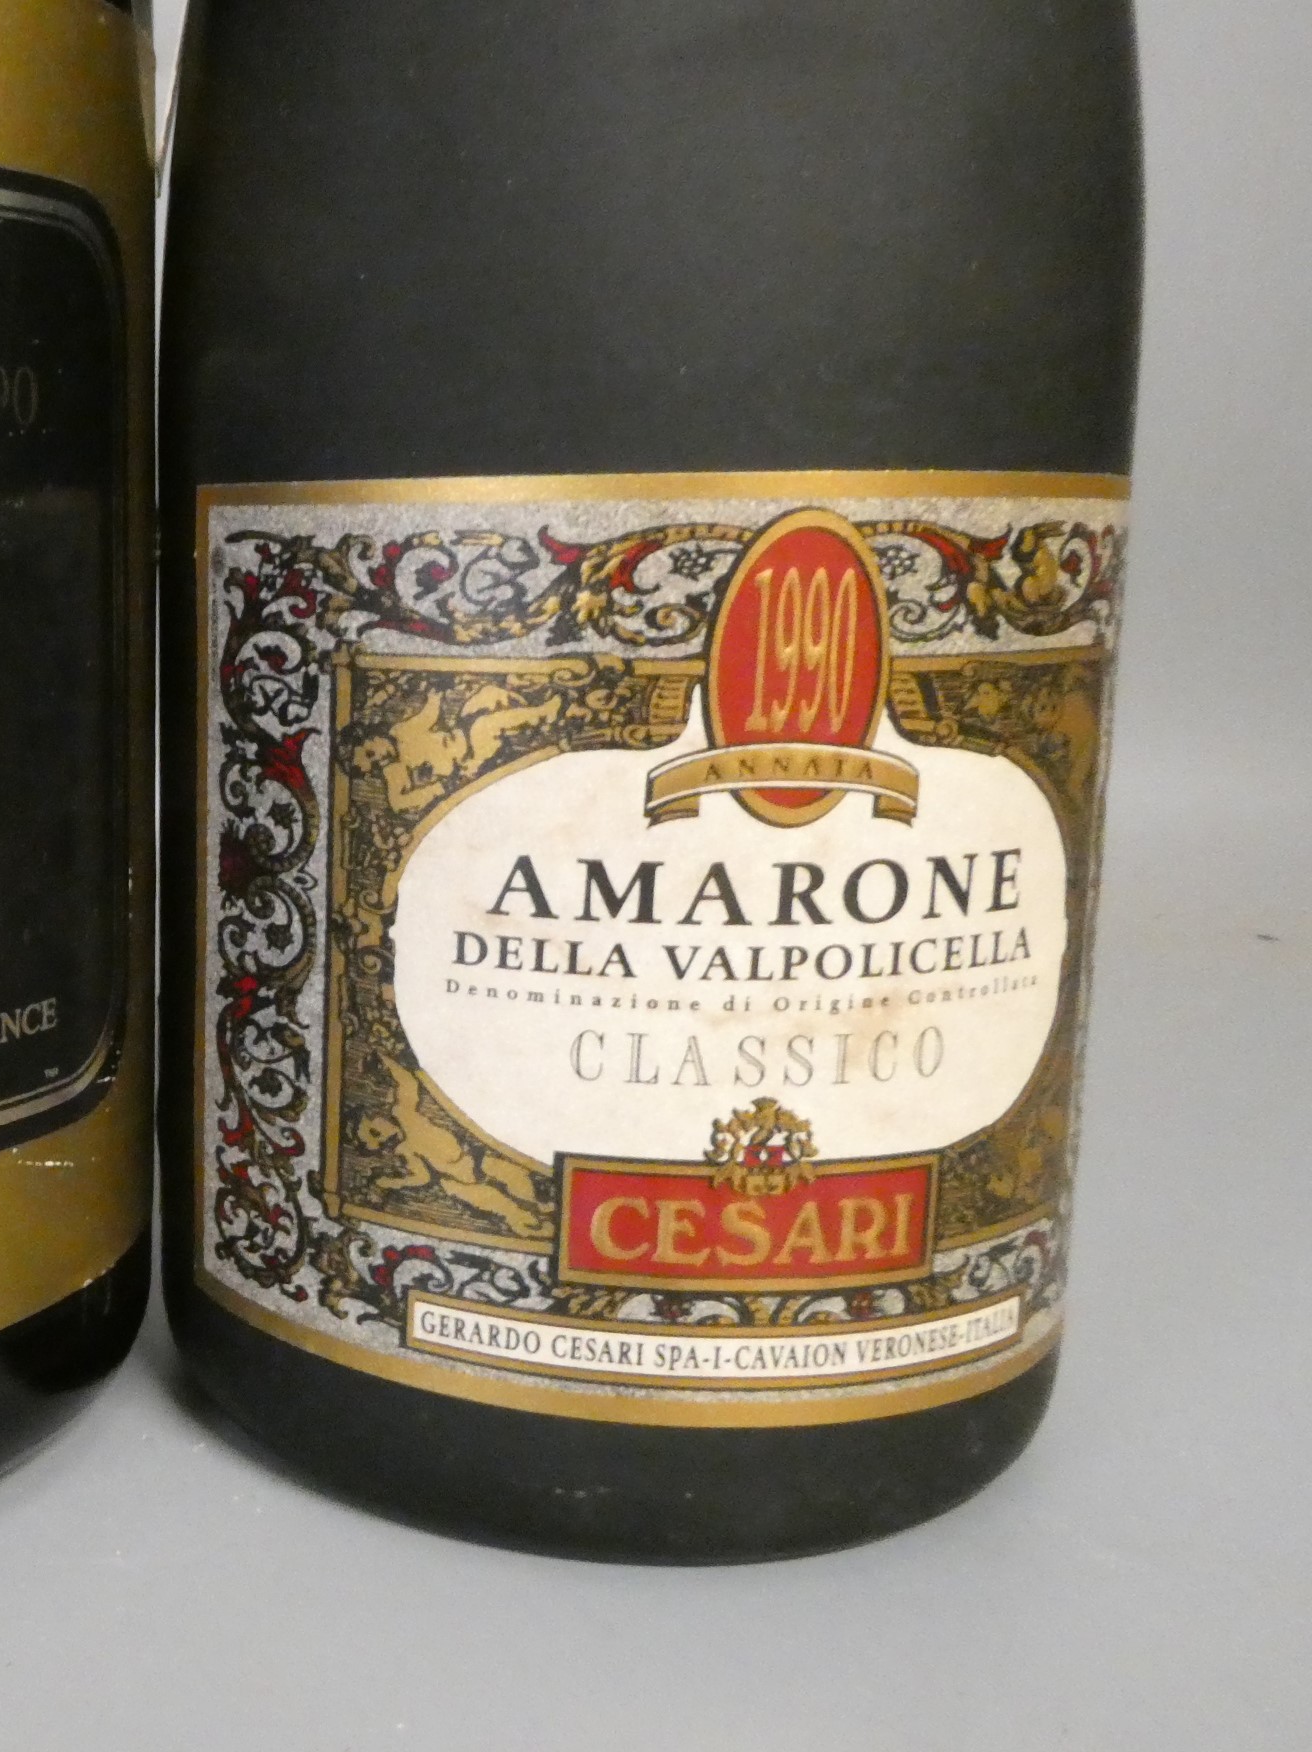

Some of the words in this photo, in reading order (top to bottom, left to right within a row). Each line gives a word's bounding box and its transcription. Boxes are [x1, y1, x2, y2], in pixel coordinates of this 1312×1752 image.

[745, 567, 857, 733] 1990
[704, 757, 873, 782] ANNATA
[486, 848, 1021, 925] AMARONE
[452, 930, 637, 978] DELLA
[662, 927, 1031, 981] VALPOLICELLA
[446, 979, 700, 1011] Denominazione
[723, 995, 751, 1012] di
[773, 994, 890, 1015] Origine
[570, 1026, 944, 1087] CLASSICO
[590, 1193, 915, 1265] CESARI
[421, 1310, 540, 1354] GERARDO
[552, 1334, 644, 1366] CESARI
